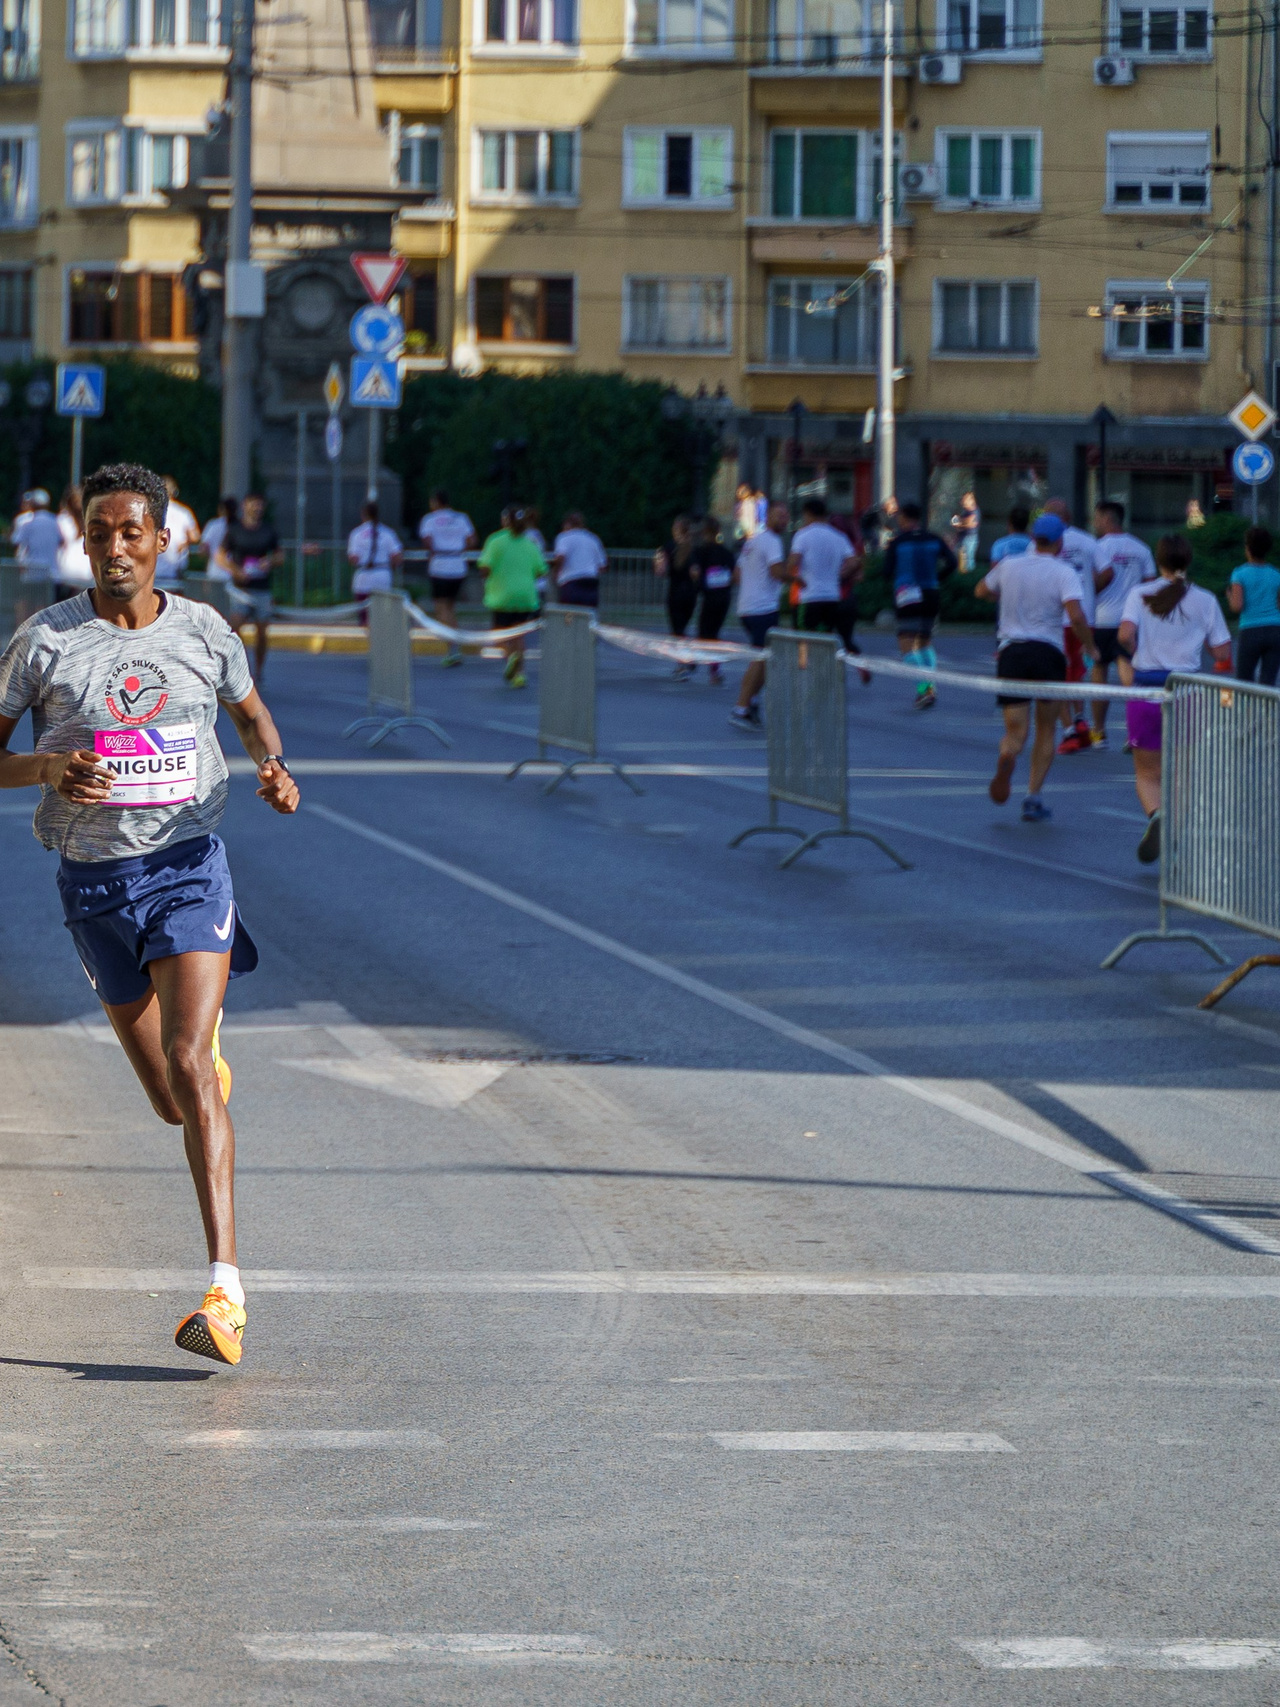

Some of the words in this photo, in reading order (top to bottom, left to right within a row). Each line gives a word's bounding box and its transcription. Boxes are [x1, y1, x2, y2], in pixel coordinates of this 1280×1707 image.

[111, 662, 129, 679] SÃO
[131, 659, 169, 685] SILVESTRE
[107, 755, 187, 775] NIGUSE
